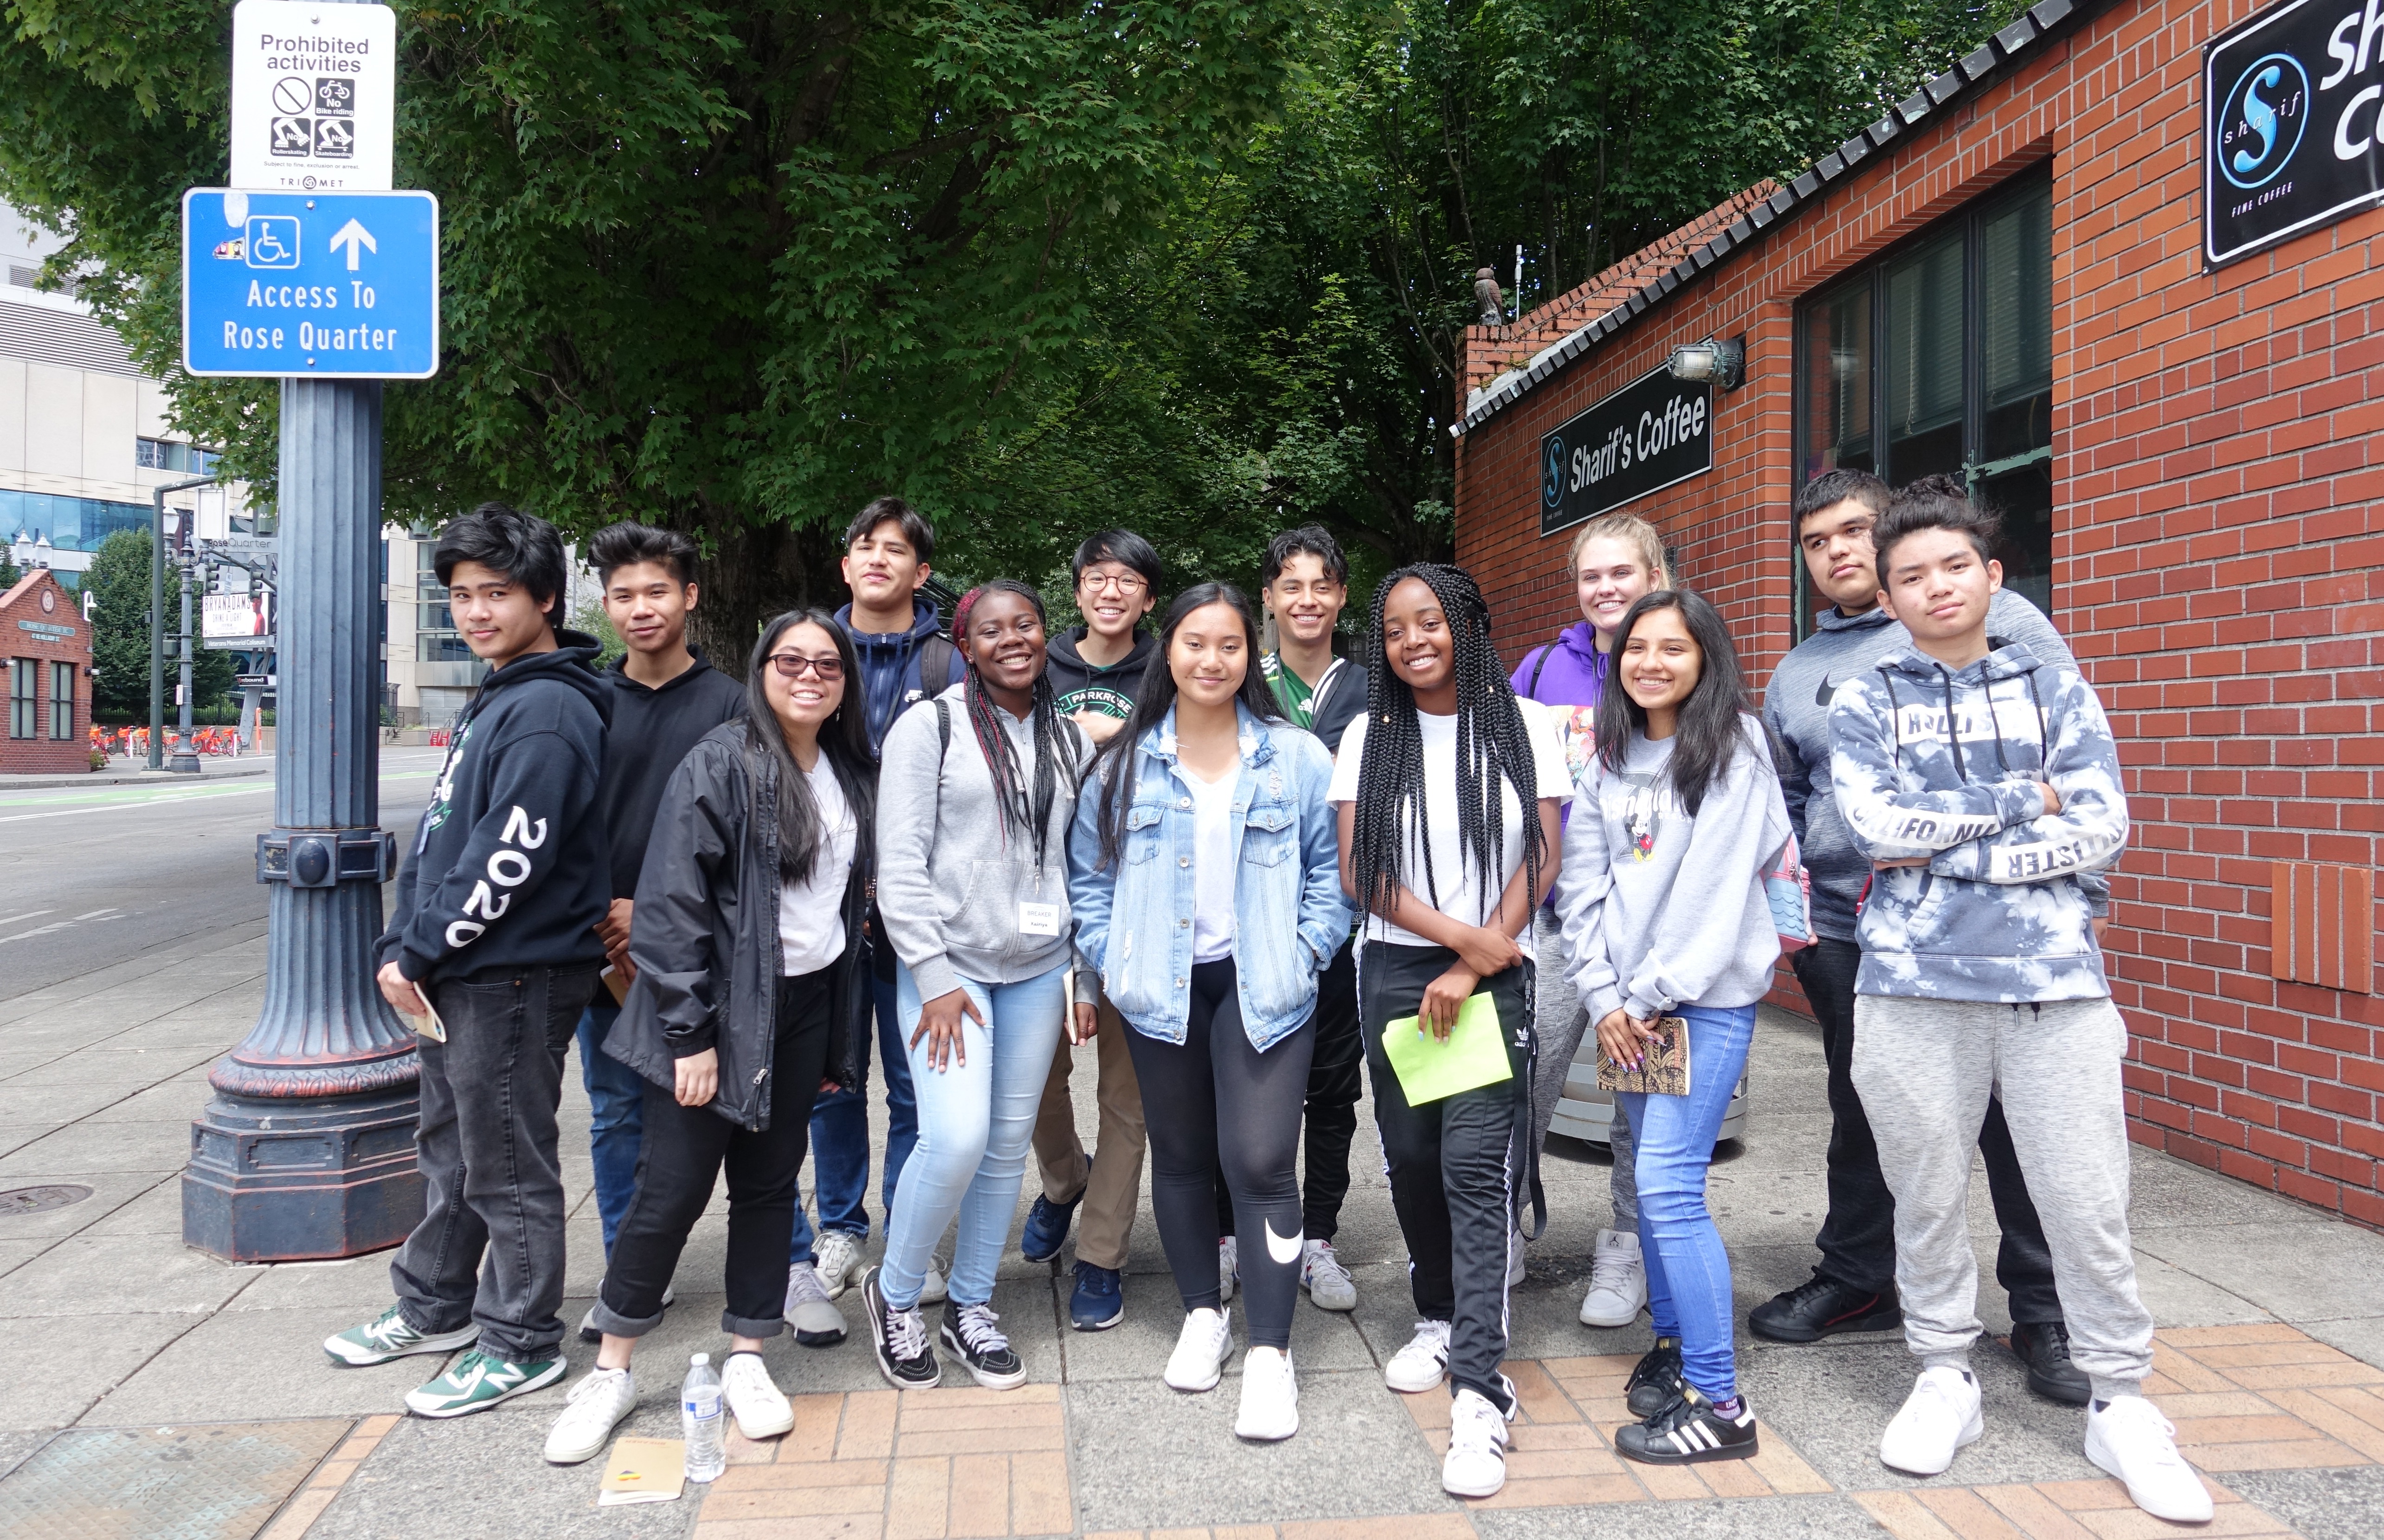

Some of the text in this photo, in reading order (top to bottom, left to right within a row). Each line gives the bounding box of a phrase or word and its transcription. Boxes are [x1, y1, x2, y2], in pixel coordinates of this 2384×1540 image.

[261, 34, 369, 55] Prohibited
[267, 54, 361, 73] activities
[327, 98, 341, 108] No
[2224, 91, 2301, 145] sharif
[2334, 84, 2384, 160] C
[280, 178, 343, 187] TRI MET
[2231, 181, 2294, 218] FINE COFFEE
[247, 279, 375, 309] Access To
[224, 321, 397, 351] Rose Quarter
[1570, 394, 1705, 493] Sharif's Coffee
[213, 613, 225, 622] SHINE
[230, 612, 242, 622] LIGHT
[1071, 692, 1132, 714] PARKROSE
[1908, 707, 2034, 735] HOLLIST
[1658, 812, 1696, 825] RESOR
[445, 805, 547, 948] 2020
